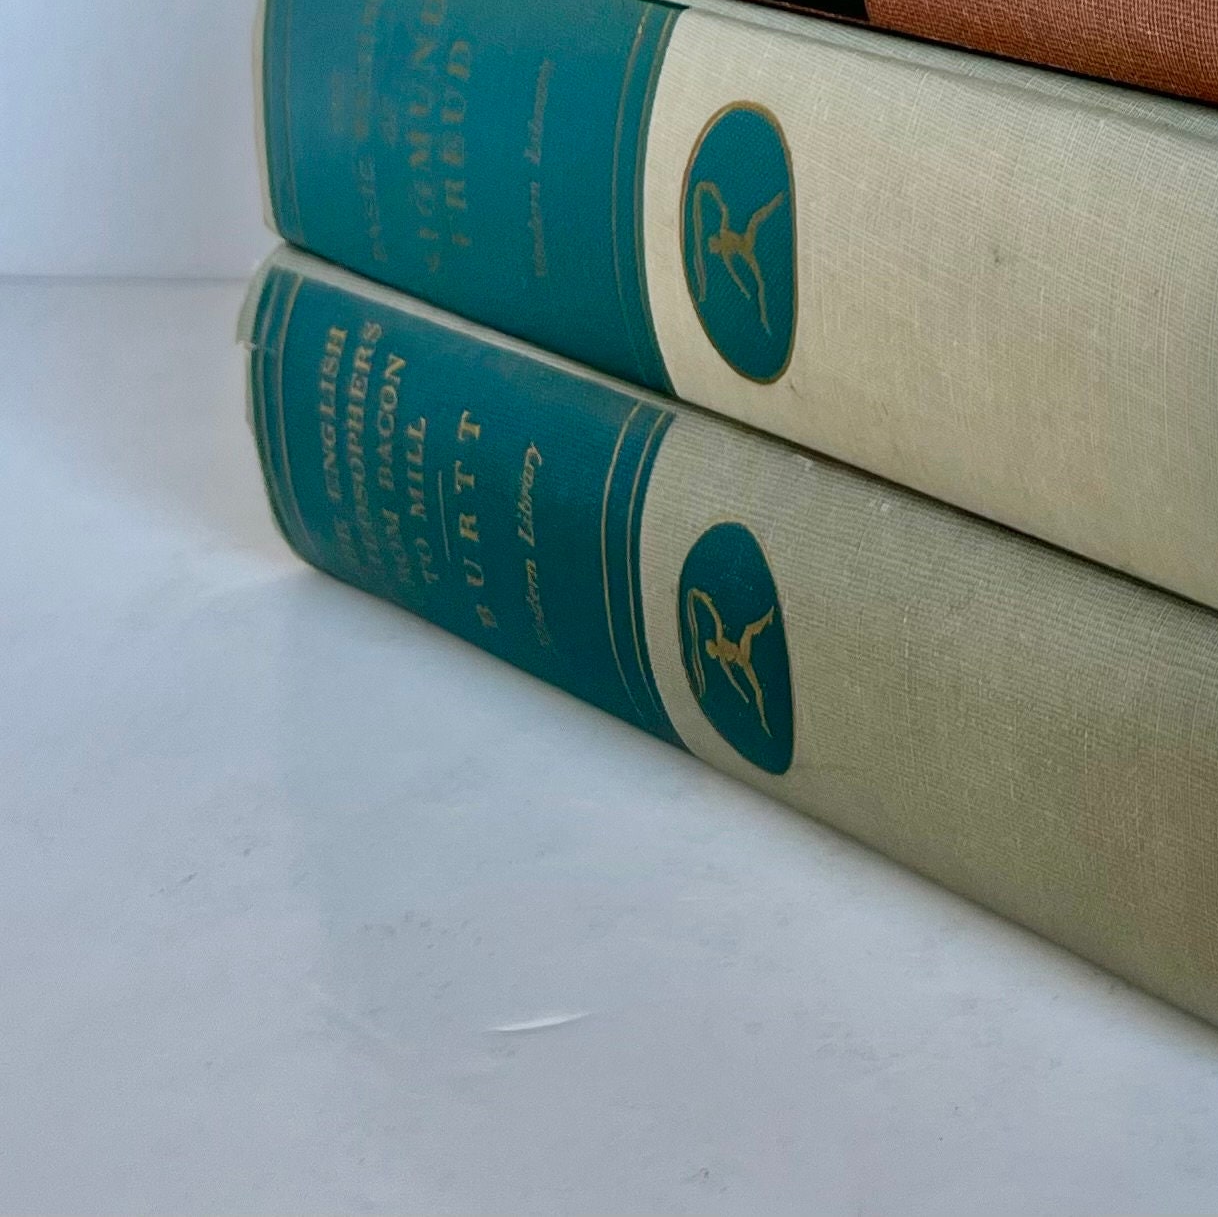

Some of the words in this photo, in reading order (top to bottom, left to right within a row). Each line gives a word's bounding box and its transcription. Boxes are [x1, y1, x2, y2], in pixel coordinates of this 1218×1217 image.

[318, 325, 348, 505] ENGLISH
[376, 352, 407, 491] BACON
[405, 415, 428, 522] MILL
[454, 409, 499, 630] BURTT
[516, 440, 544, 548] Library
